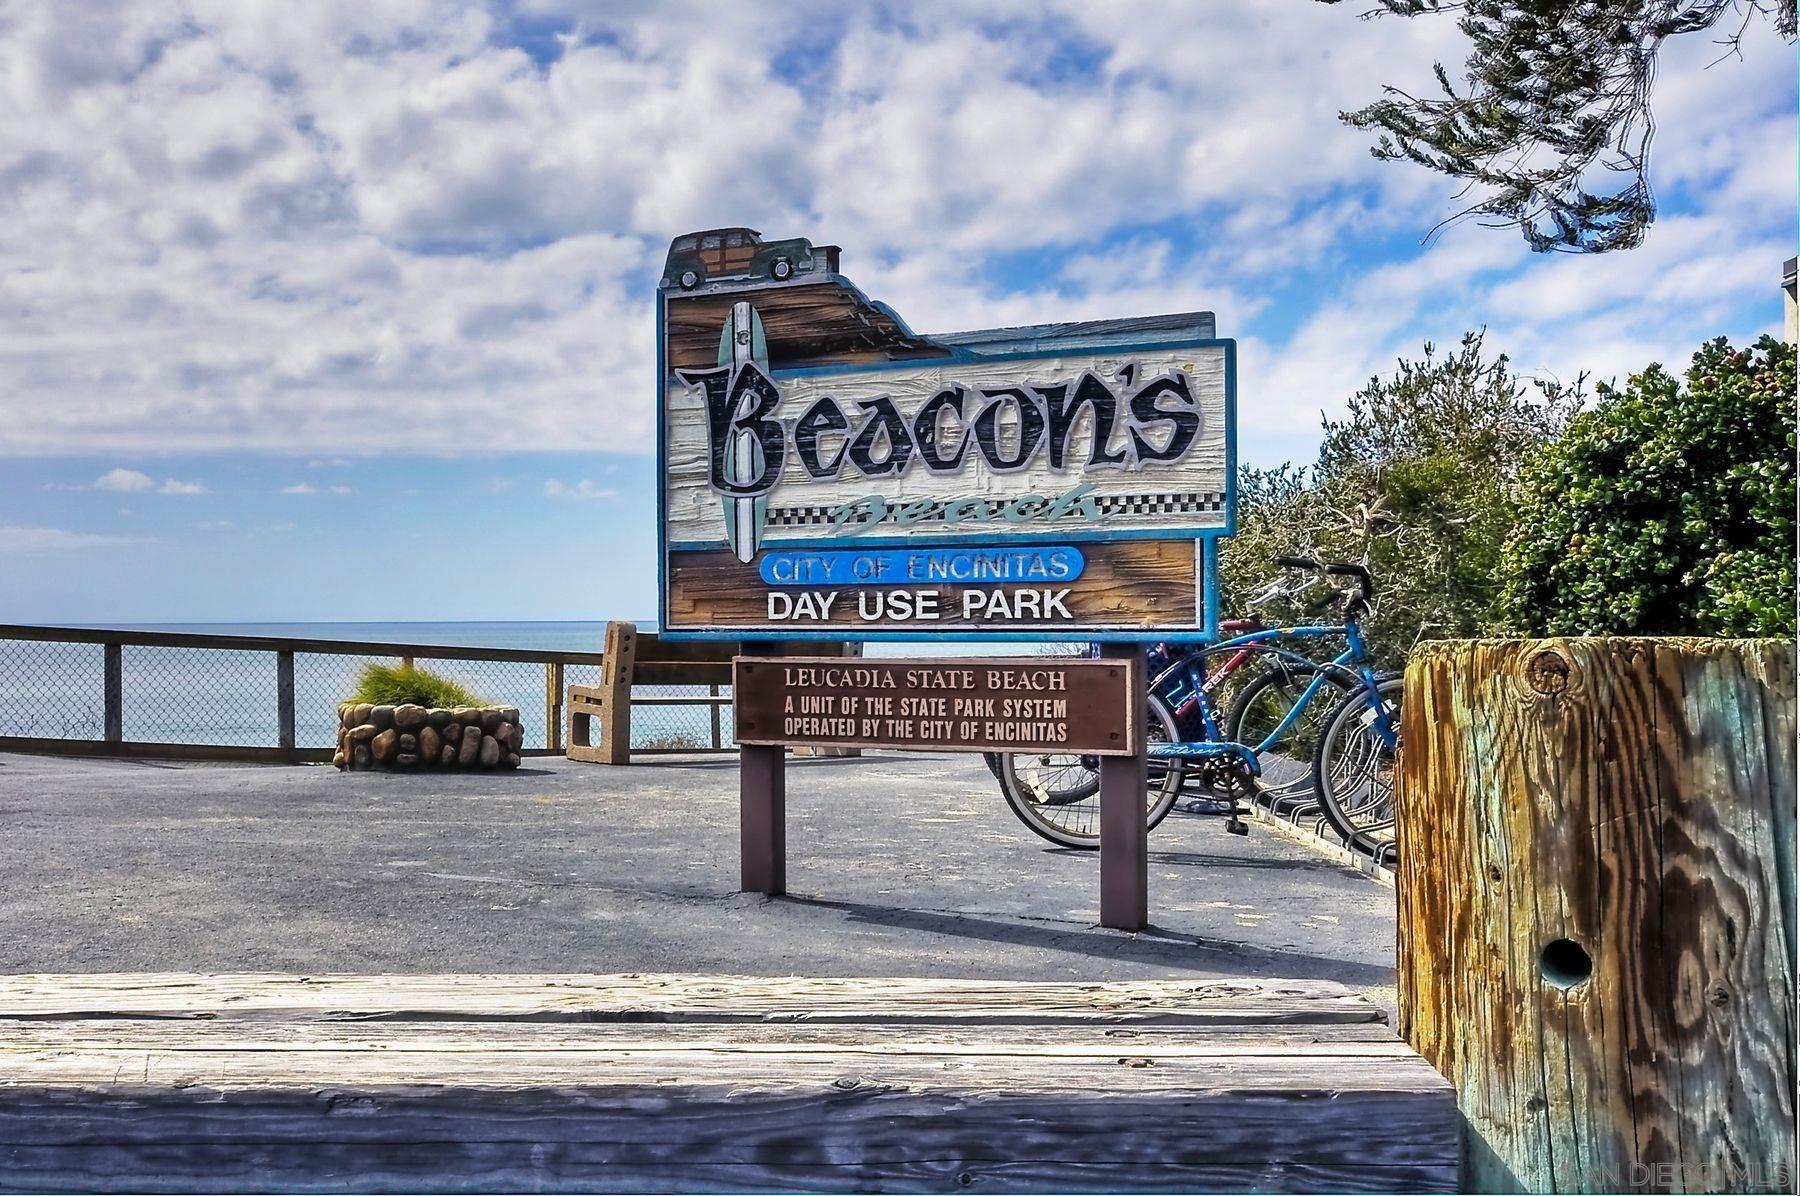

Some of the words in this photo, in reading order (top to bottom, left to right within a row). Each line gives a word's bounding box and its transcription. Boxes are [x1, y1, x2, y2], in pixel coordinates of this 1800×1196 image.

[675, 359, 1200, 497] Beacon's
[826, 482, 1121, 536] Beach
[771, 556, 837, 582] CITY
[852, 555, 892, 580] OF
[907, 551, 1070, 580] ENCINITAS
[767, 591, 838, 621] DAY
[858, 589, 940, 621] USE
[962, 588, 1074, 620] PARK
[784, 668, 897, 689] LEUCADIA
[906, 669, 976, 690] STATE
[986, 670, 1067, 691] BEACH
[784, 695, 794, 714] A
[800, 696, 835, 715] UNIT
[841, 697, 859, 715] OF
[864, 697, 893, 716] THE
[900, 698, 947, 717] STATE
[954, 698, 995, 718] PARK
[1002, 699, 1067, 719] SYSTEM
[784, 717, 856, 736] OPERATED
[862, 718, 880, 738] BY
[885, 719, 914, 739] THE
[920, 720, 954, 740] CITY
[960, 721, 978, 740] OF
[985, 721, 1067, 742] ENCINITAS
